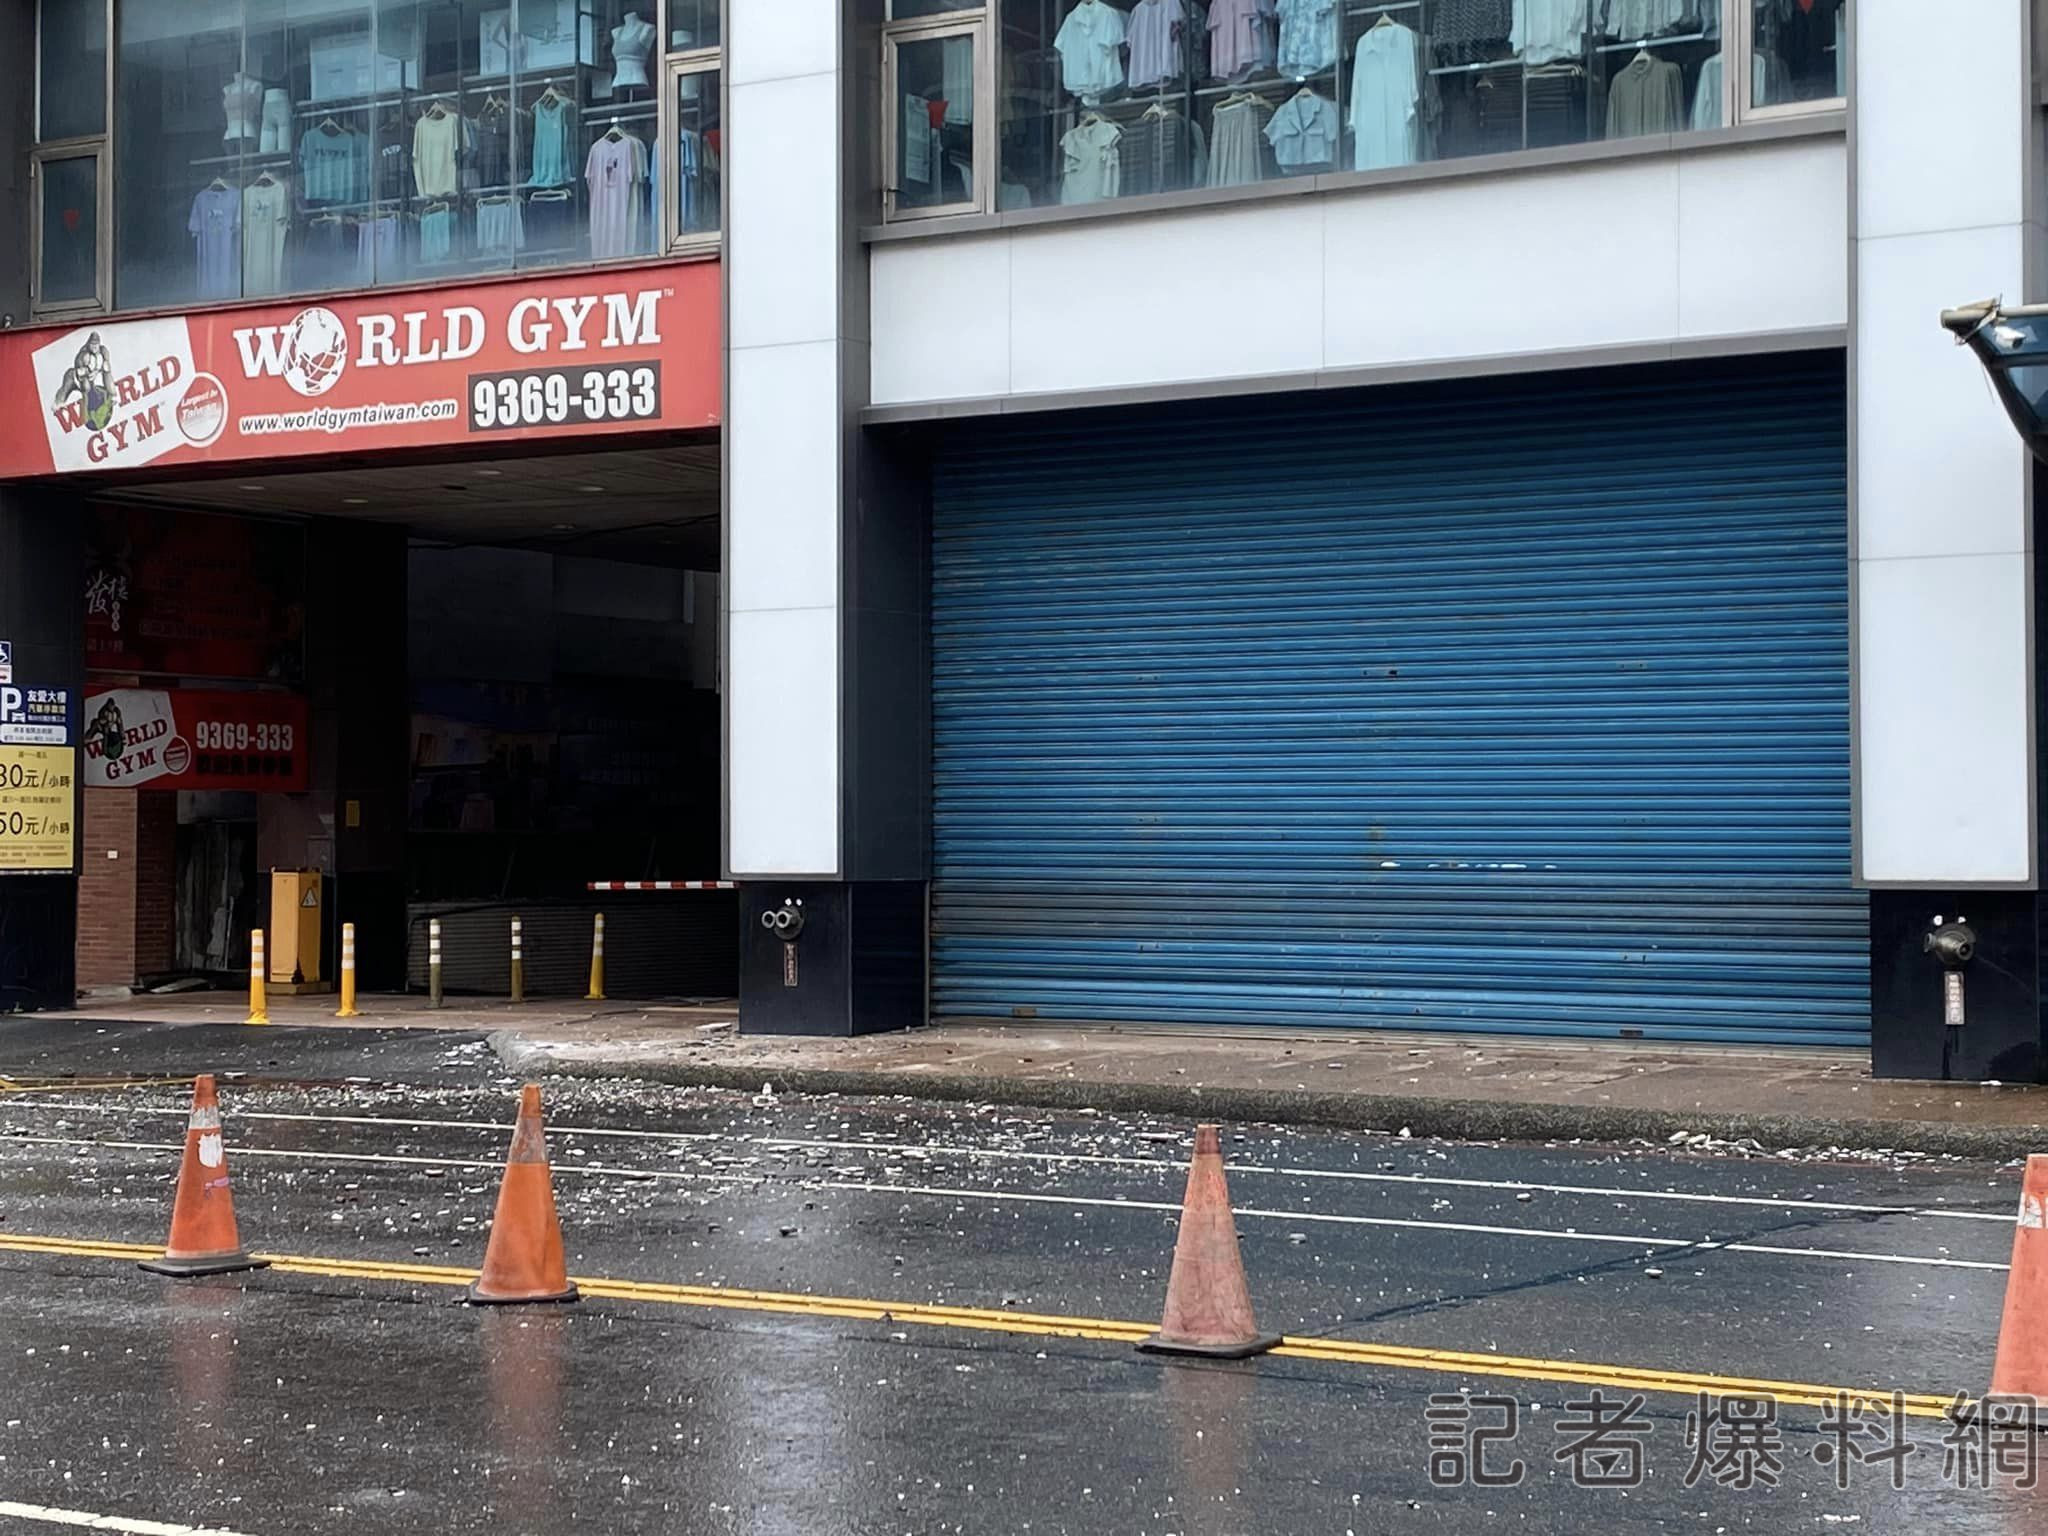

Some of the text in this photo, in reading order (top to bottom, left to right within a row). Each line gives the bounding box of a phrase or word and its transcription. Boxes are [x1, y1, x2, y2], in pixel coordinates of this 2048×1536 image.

[474, 367, 656, 427] 9369-333
[241, 401, 456, 432] www.worldgymtaiwan.com
[86, 405, 165, 463] GYM
[195, 721, 294, 751] 9369-333
[105, 748, 157, 780] GYM
